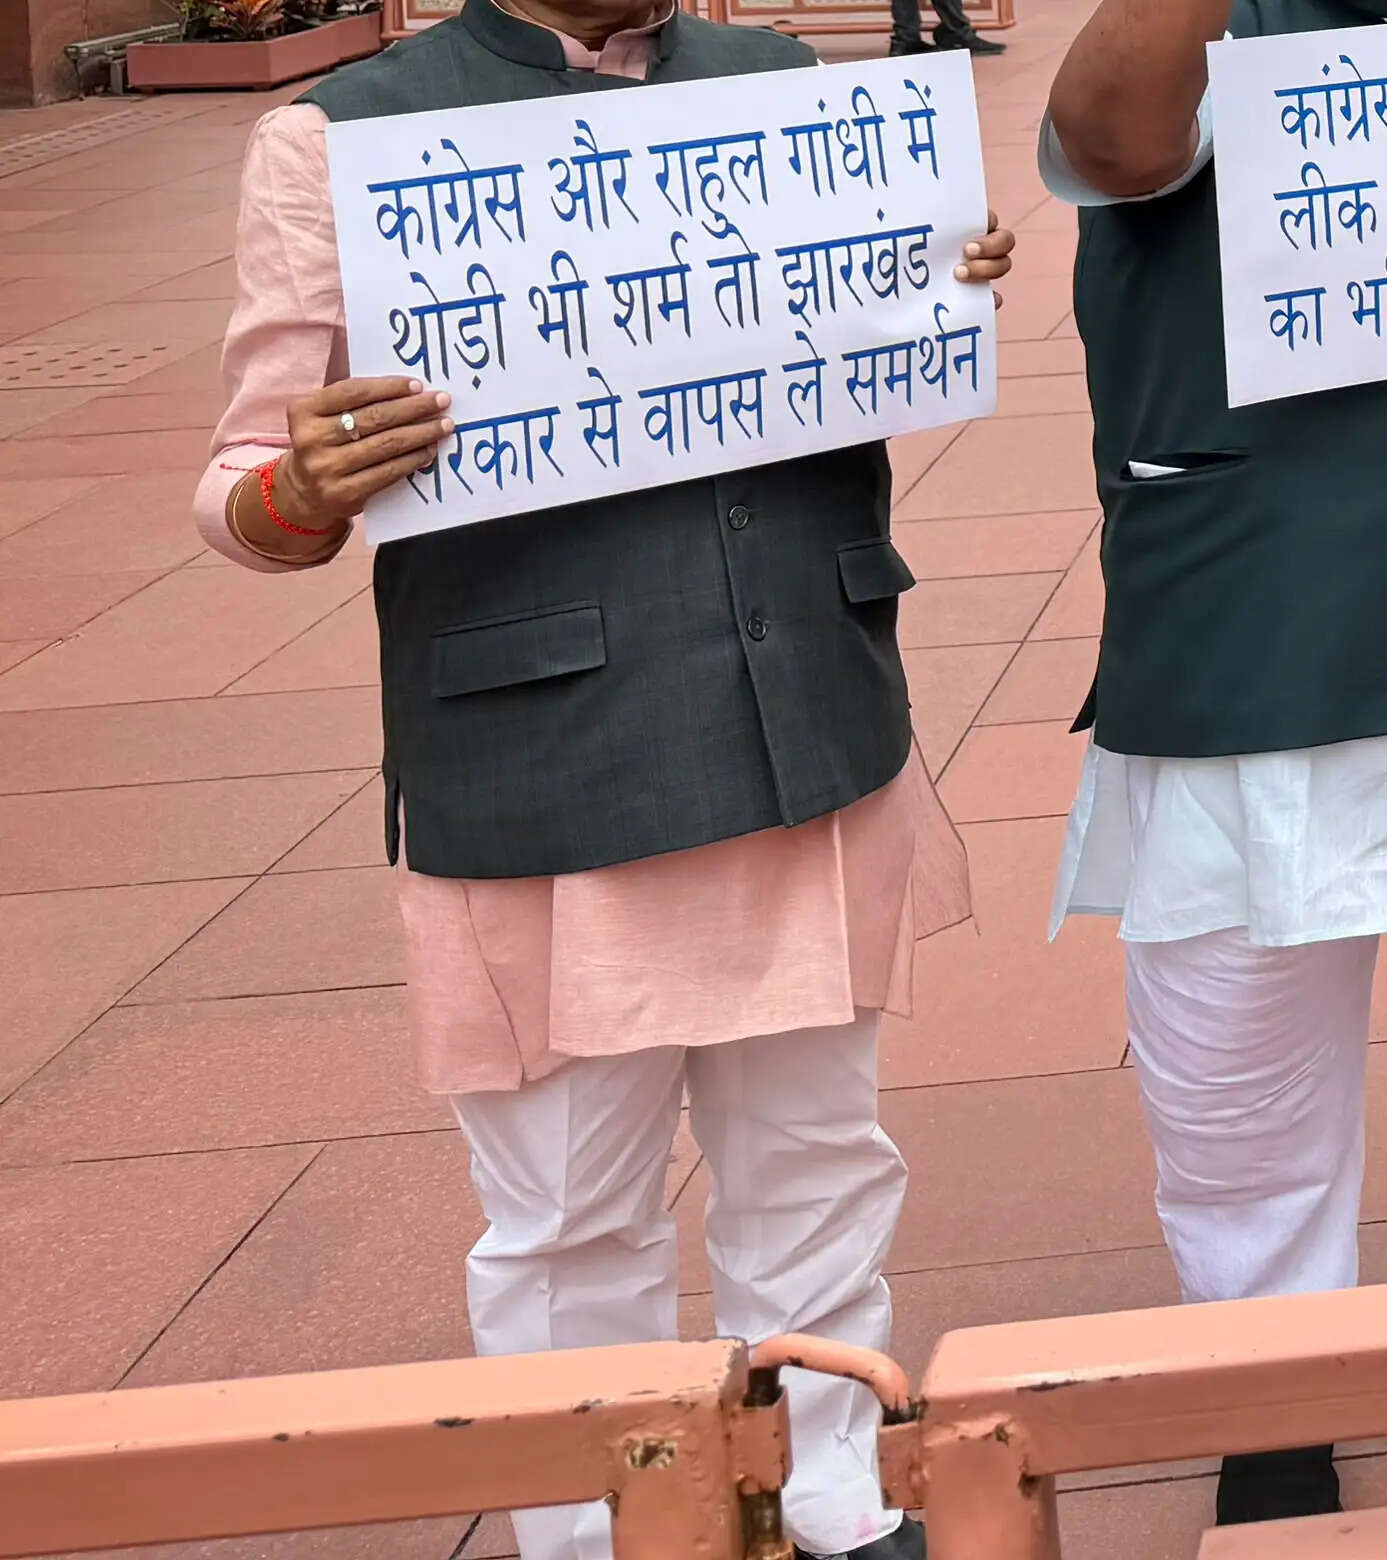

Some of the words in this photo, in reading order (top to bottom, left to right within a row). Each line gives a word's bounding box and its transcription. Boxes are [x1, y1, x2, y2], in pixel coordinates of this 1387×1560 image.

[366, 138, 526, 260] कांग्रेस
[547, 119, 639, 232] और
[647, 131, 768, 239] राहुल
[780, 86, 888, 197] गांधी
[898, 79, 939, 179] में
[1273, 162, 1378, 250] लीक
[389, 263, 506, 390] थोड़ी
[528, 250, 589, 359] भी
[604, 231, 692, 346] शर्म
[707, 223, 761, 329] तो
[774, 208, 934, 328] झारखंड
[1264, 287, 1327, 351] का
[576, 367, 623, 468] से
[637, 368, 767, 457] वापस
[781, 330, 827, 426] ले
[841, 302, 982, 416] समर्थन
